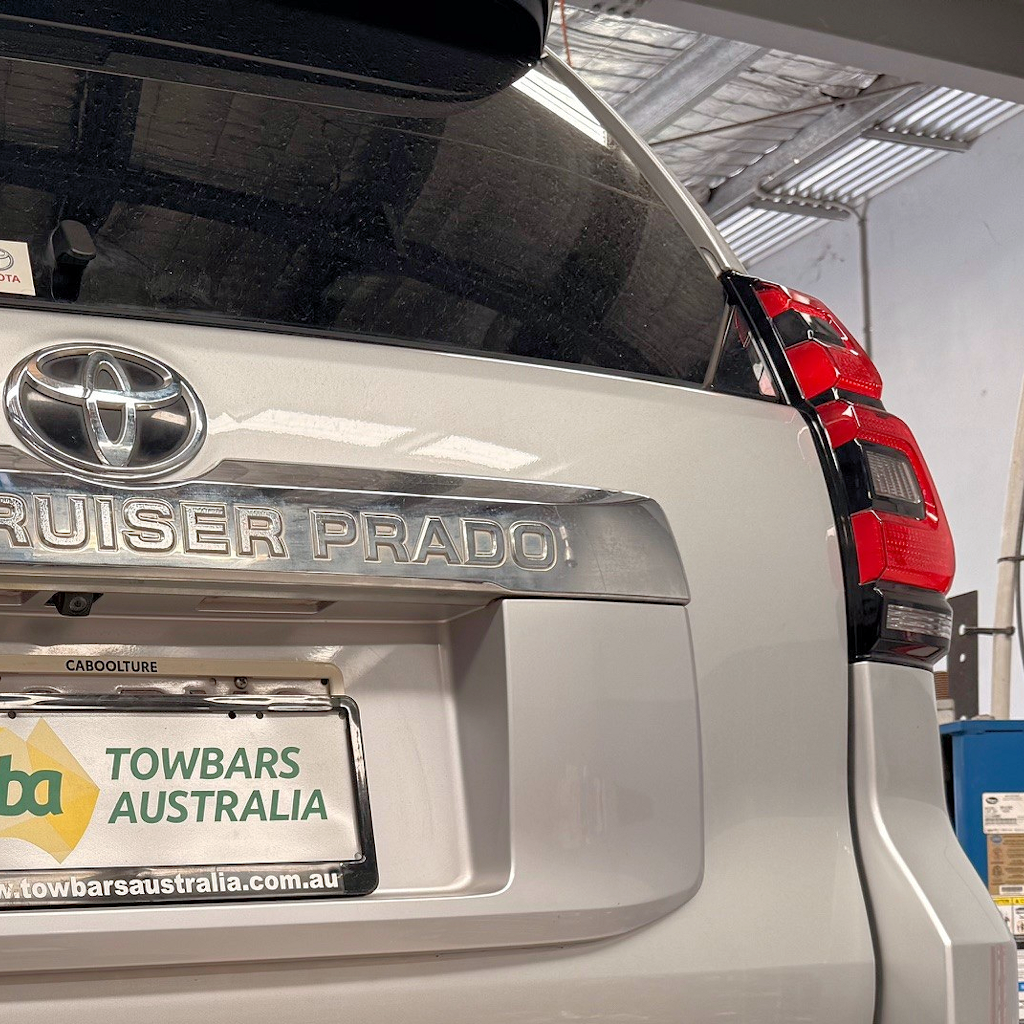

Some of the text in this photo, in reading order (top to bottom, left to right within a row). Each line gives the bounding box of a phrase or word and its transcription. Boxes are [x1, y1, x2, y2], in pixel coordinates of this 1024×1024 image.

[309, 506, 566, 572] PRADO
[65, 659, 158, 674] CABOOLTURE
[105, 746, 301, 780] TOWBARS
[108, 789, 329, 825] AUSTRALIA
